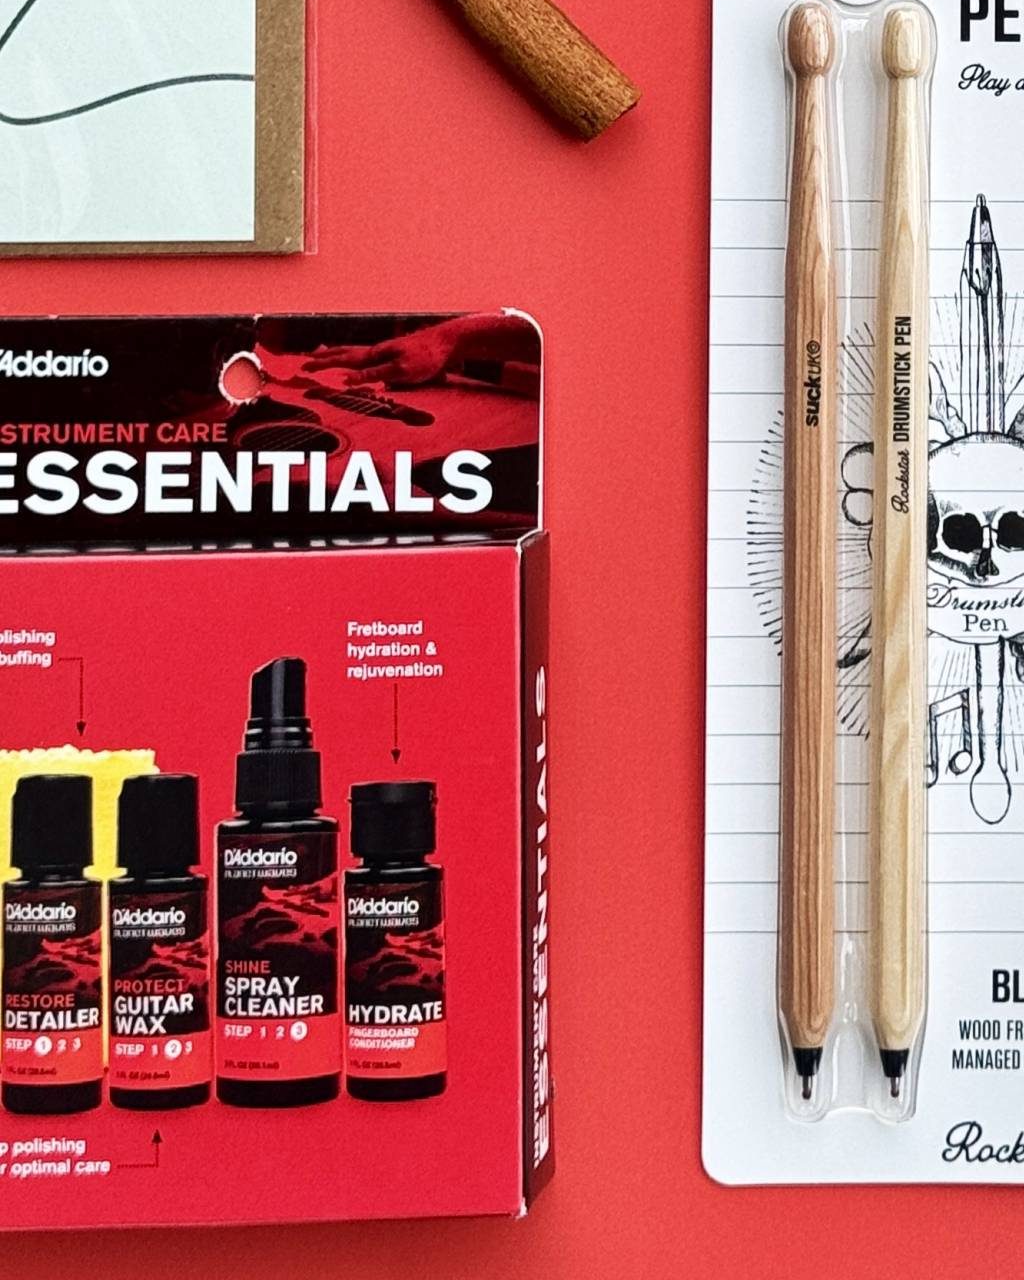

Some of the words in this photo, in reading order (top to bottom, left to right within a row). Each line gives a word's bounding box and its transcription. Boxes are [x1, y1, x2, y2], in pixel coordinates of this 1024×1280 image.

[958, 63, 1010, 96] Play
[895, 316, 911, 348] PEN
[893, 351, 911, 442] DRUMSTICK
[156, 422, 228, 443] CARE
[891, 449, 910, 514] Rockstar
[347, 620, 423, 636] Fretboard
[963, 614, 1009, 633] Pen
[347, 641, 420, 660] hydration
[425, 641, 437, 656] &
[347, 661, 443, 681] rejuvenation
[536, 665, 550, 1161] ESSENTIALS
[225, 960, 271, 973] SHINE
[114, 979, 185, 994] PROTECT
[225, 976, 300, 995] SPRAY
[6, 994, 75, 1008] RESTORE
[115, 993, 194, 1015] GUITAR
[225, 994, 324, 1016] CLEANER
[5, 1007, 99, 1030] DETAILER
[349, 1001, 442, 1023] HYDRATE
[116, 1015, 167, 1035] WAX
[224, 1024, 252, 1037] STEP
[260, 1026, 267, 1038] 1
[276, 1025, 285, 1038] 2
[959, 1020, 1001, 1040] WOOD
[5, 1038, 33, 1051] STEP
[115, 1043, 144, 1055] STEP
[952, 1049, 1020, 1069] MANAGED
[12, 1137, 86, 1158] polishing
[10, 1159, 71, 1178] optimal
[74, 1163, 110, 1174] care
